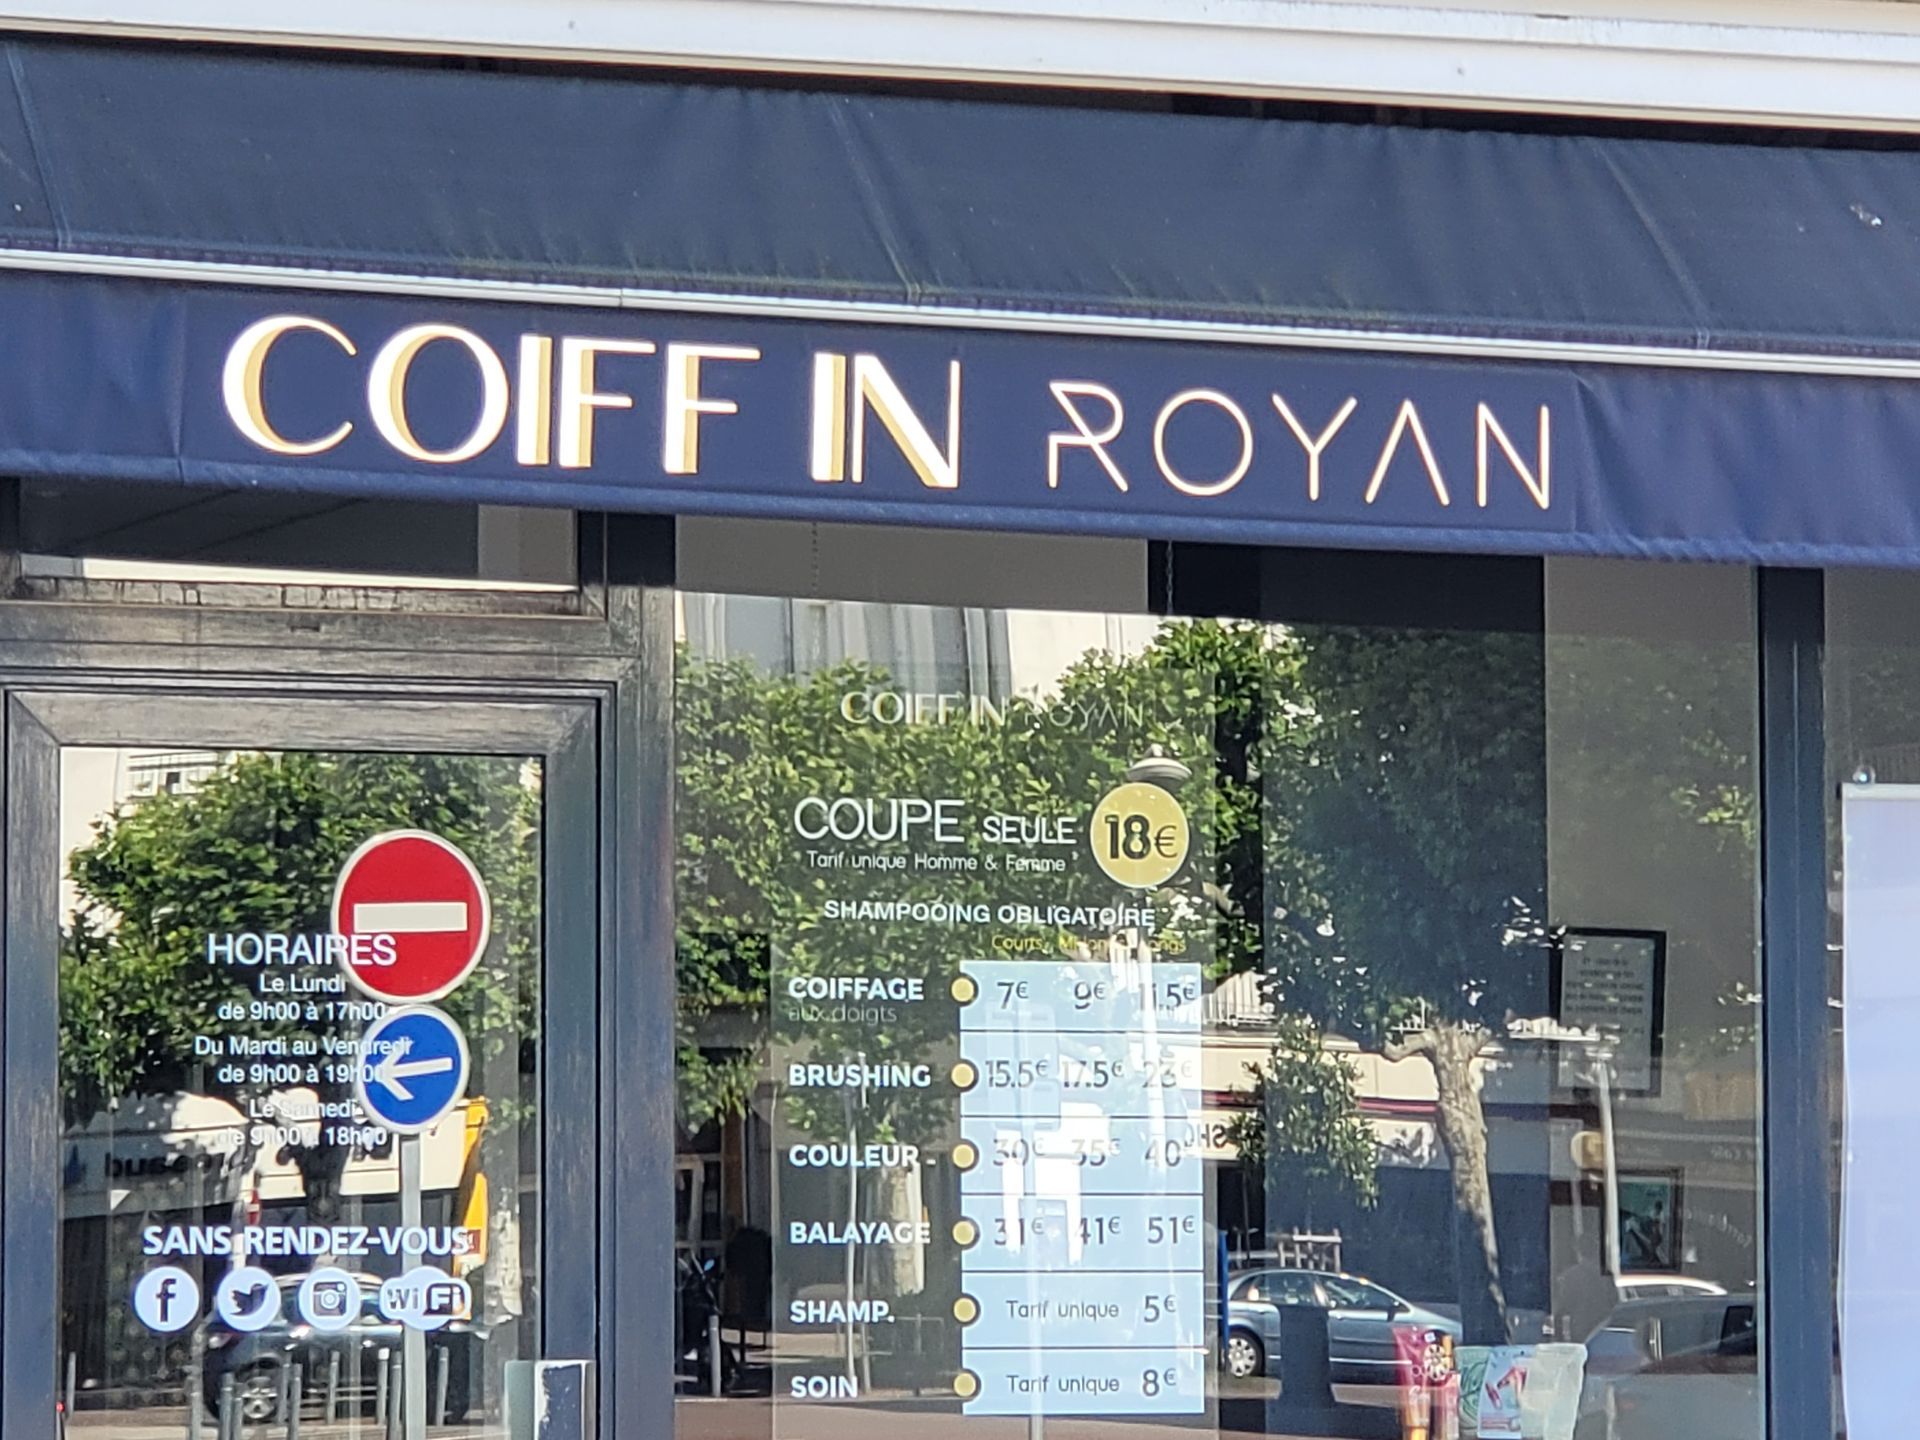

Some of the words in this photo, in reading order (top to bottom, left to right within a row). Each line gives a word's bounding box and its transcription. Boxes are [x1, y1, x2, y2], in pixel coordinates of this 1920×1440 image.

[222, 314, 761, 475] COIFF
[810, 351, 961, 489] IN
[1046, 380, 1550, 510] ROYAN
[840, 691, 964, 725] COIFF
[970, 694, 1006, 727] IN
[1024, 700, 1144, 728] ROYAN
[793, 797, 966, 843] COUPE
[982, 815, 1078, 846] SEULE
[1104, 813, 1179, 861] 18€
[807, 850, 844, 869] Tarif
[851, 853, 907, 873] unique
[914, 852, 978, 871] Homme
[985, 854, 998, 871] &
[1005, 854, 1066, 873] Femme
[823, 899, 991, 923] SHAMPOOING
[997, 904, 1156, 928] OBLIGATOIRE
[207, 932, 397, 967] HORAIRES
[991, 934, 1043, 951] Courts
[1143, 936, 1187, 955] ongs
[260, 973, 285, 993] Le
[290, 973, 347, 993] Lundi
[787, 976, 925, 1001] COIFFAGE
[996, 980, 1029, 1011] 7€
[1073, 980, 1107, 1011] 9€
[218, 1002, 246, 1020] de
[249, 1002, 300, 1021] 9h00
[305, 1002, 319, 1021] à
[325, 1002, 386, 1021] 17h00
[831, 1003, 898, 1026] doigts
[194, 1036, 224, 1056] Du
[229, 1036, 288, 1056] Mardi
[292, 1039, 317, 1056] au
[321, 1036, 414, 1056] Vendredi
[218, 1064, 246, 1083] de
[249, 1064, 300, 1084] 9h00
[305, 1064, 320, 1084] à
[788, 1063, 932, 1088] BRUSHING
[984, 1059, 1049, 1089] 15.5€
[249, 1098, 275, 1118] Le
[325, 1126, 388, 1146] 18h00
[788, 1143, 920, 1168] COULEUR
[142, 1225, 232, 1256] SANS
[244, 1225, 469, 1256] RENDEZ-VOUS
[789, 1221, 931, 1245] BALAYAGE
[993, 1216, 1045, 1246] 31€
[1075, 1215, 1122, 1246] 41€
[1147, 1215, 1196, 1245] 51€
[789, 1299, 896, 1324] SHAMP.
[1006, 1299, 1049, 1319] Tarif
[1057, 1302, 1120, 1322] unique
[1143, 1294, 1177, 1324] 5€
[790, 1375, 859, 1399] SOIN
[1006, 1374, 1050, 1394] Tarif
[1057, 1377, 1120, 1396] unique
[1141, 1367, 1177, 1398] 8€
